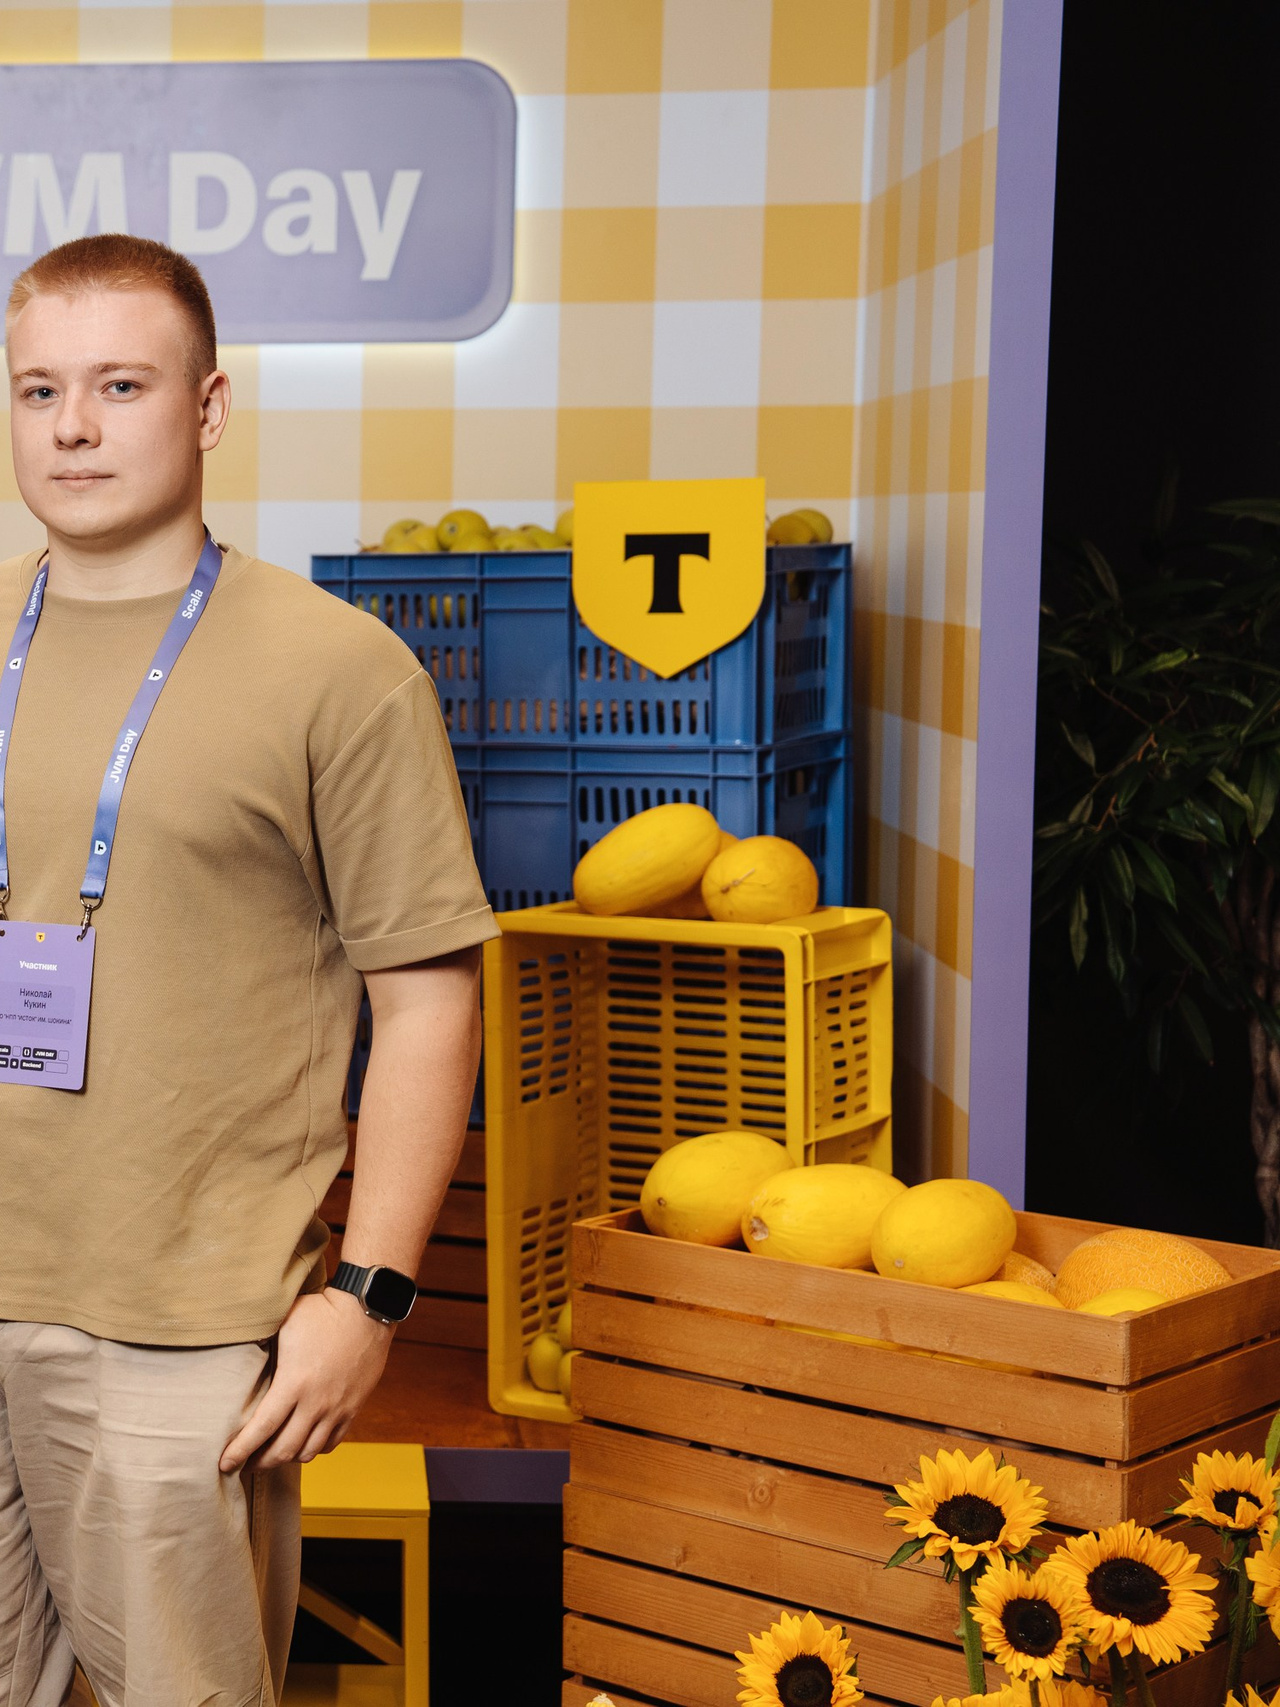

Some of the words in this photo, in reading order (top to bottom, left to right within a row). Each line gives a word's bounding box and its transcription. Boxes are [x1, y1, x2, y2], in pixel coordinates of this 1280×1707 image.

[170, 151, 423, 281] Day
[624, 532, 710, 614] T
[26, 572, 45, 617] Backend
[182, 589, 204, 619] Scala
[110, 754, 127, 783] JVM
[120, 729, 138, 753] Day
[19, 960, 58, 971] Участник
[19, 988, 53, 999] Николай
[23, 999, 46, 1010] Кукин
